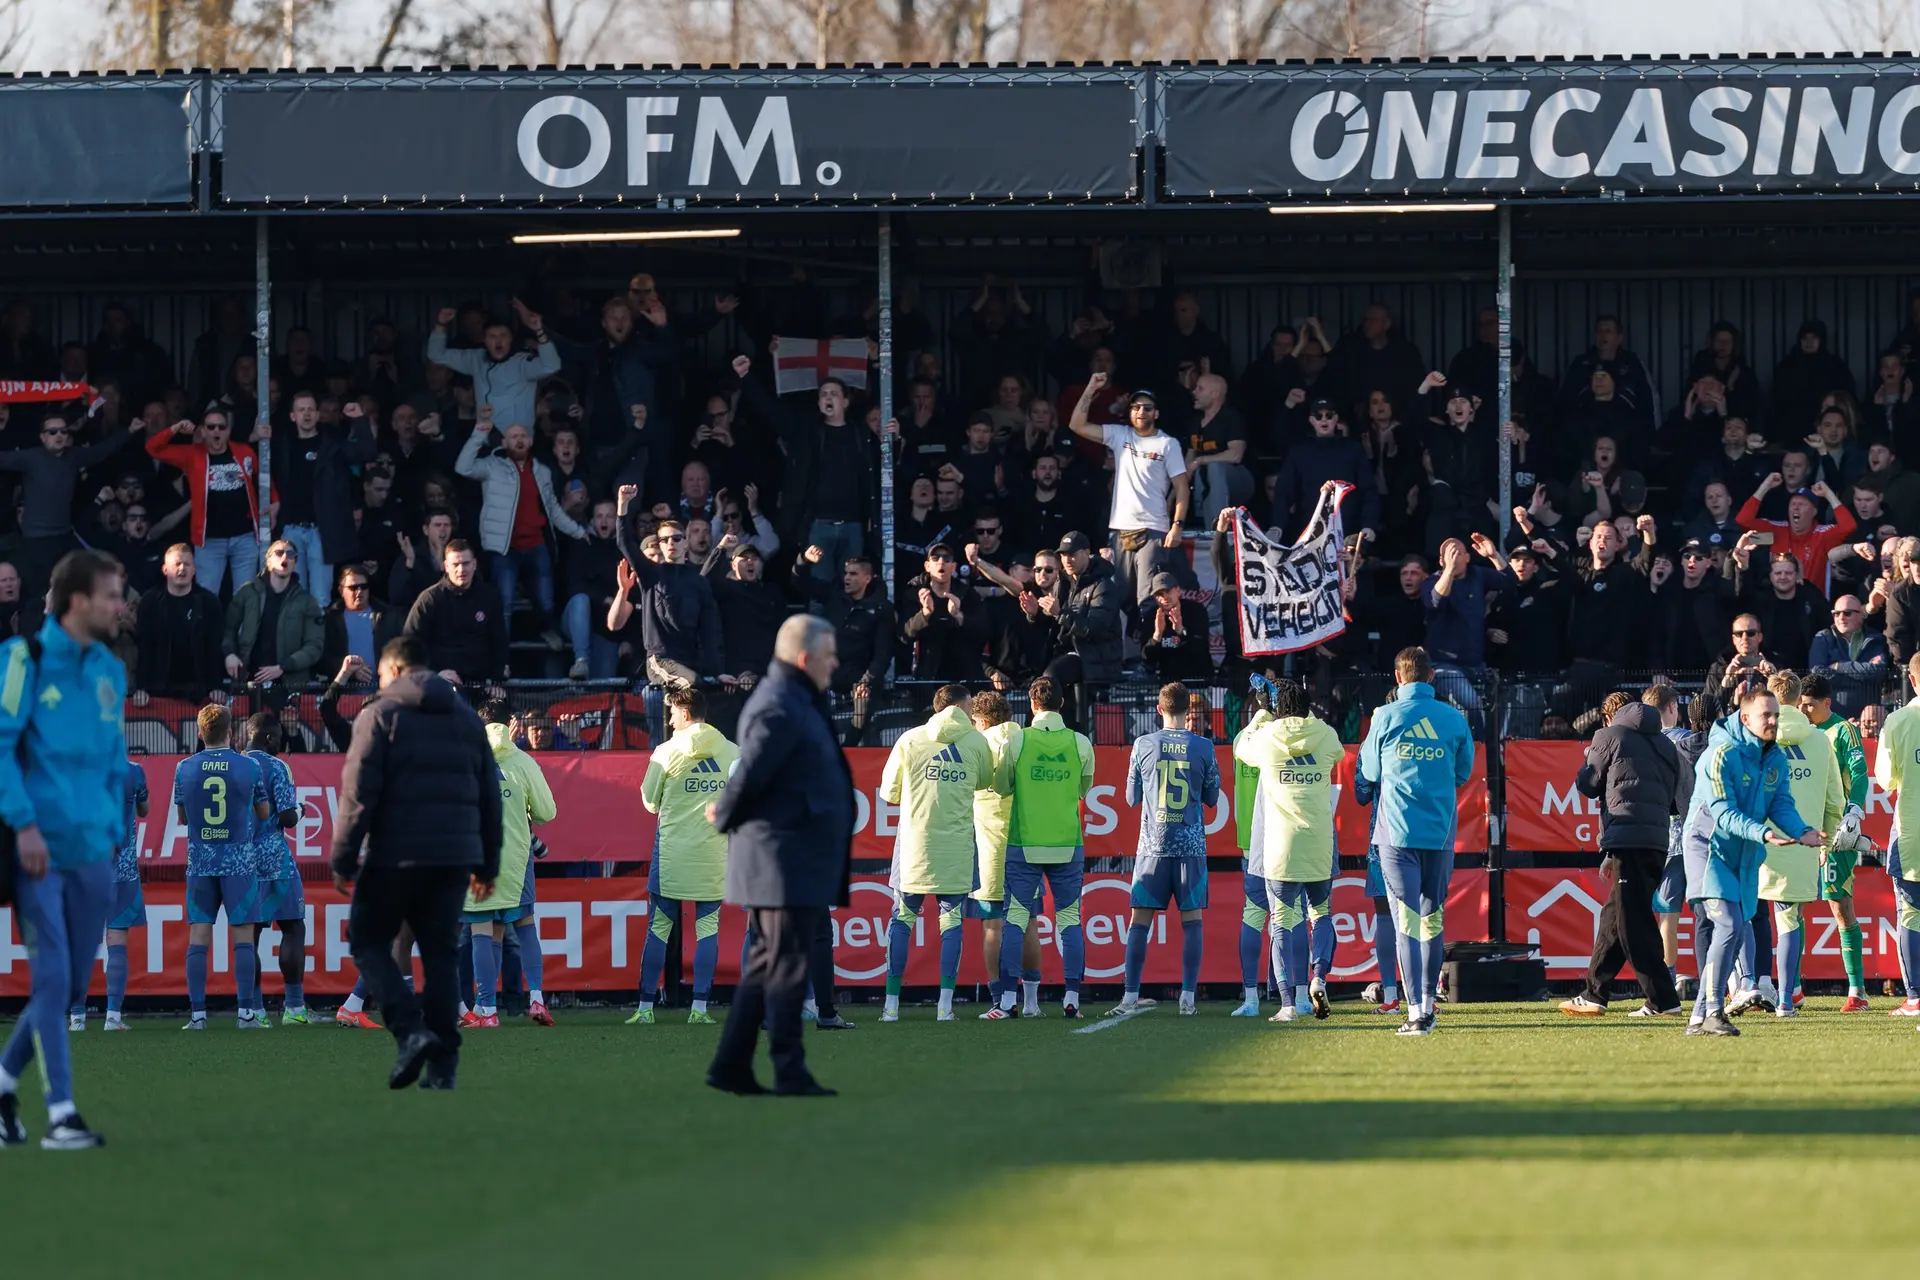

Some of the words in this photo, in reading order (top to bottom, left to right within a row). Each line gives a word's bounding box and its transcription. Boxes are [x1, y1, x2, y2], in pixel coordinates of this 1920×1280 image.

[203, 776, 227, 825] 3
[1156, 760, 1190, 810] 15
[1824, 861, 1837, 882] 16
